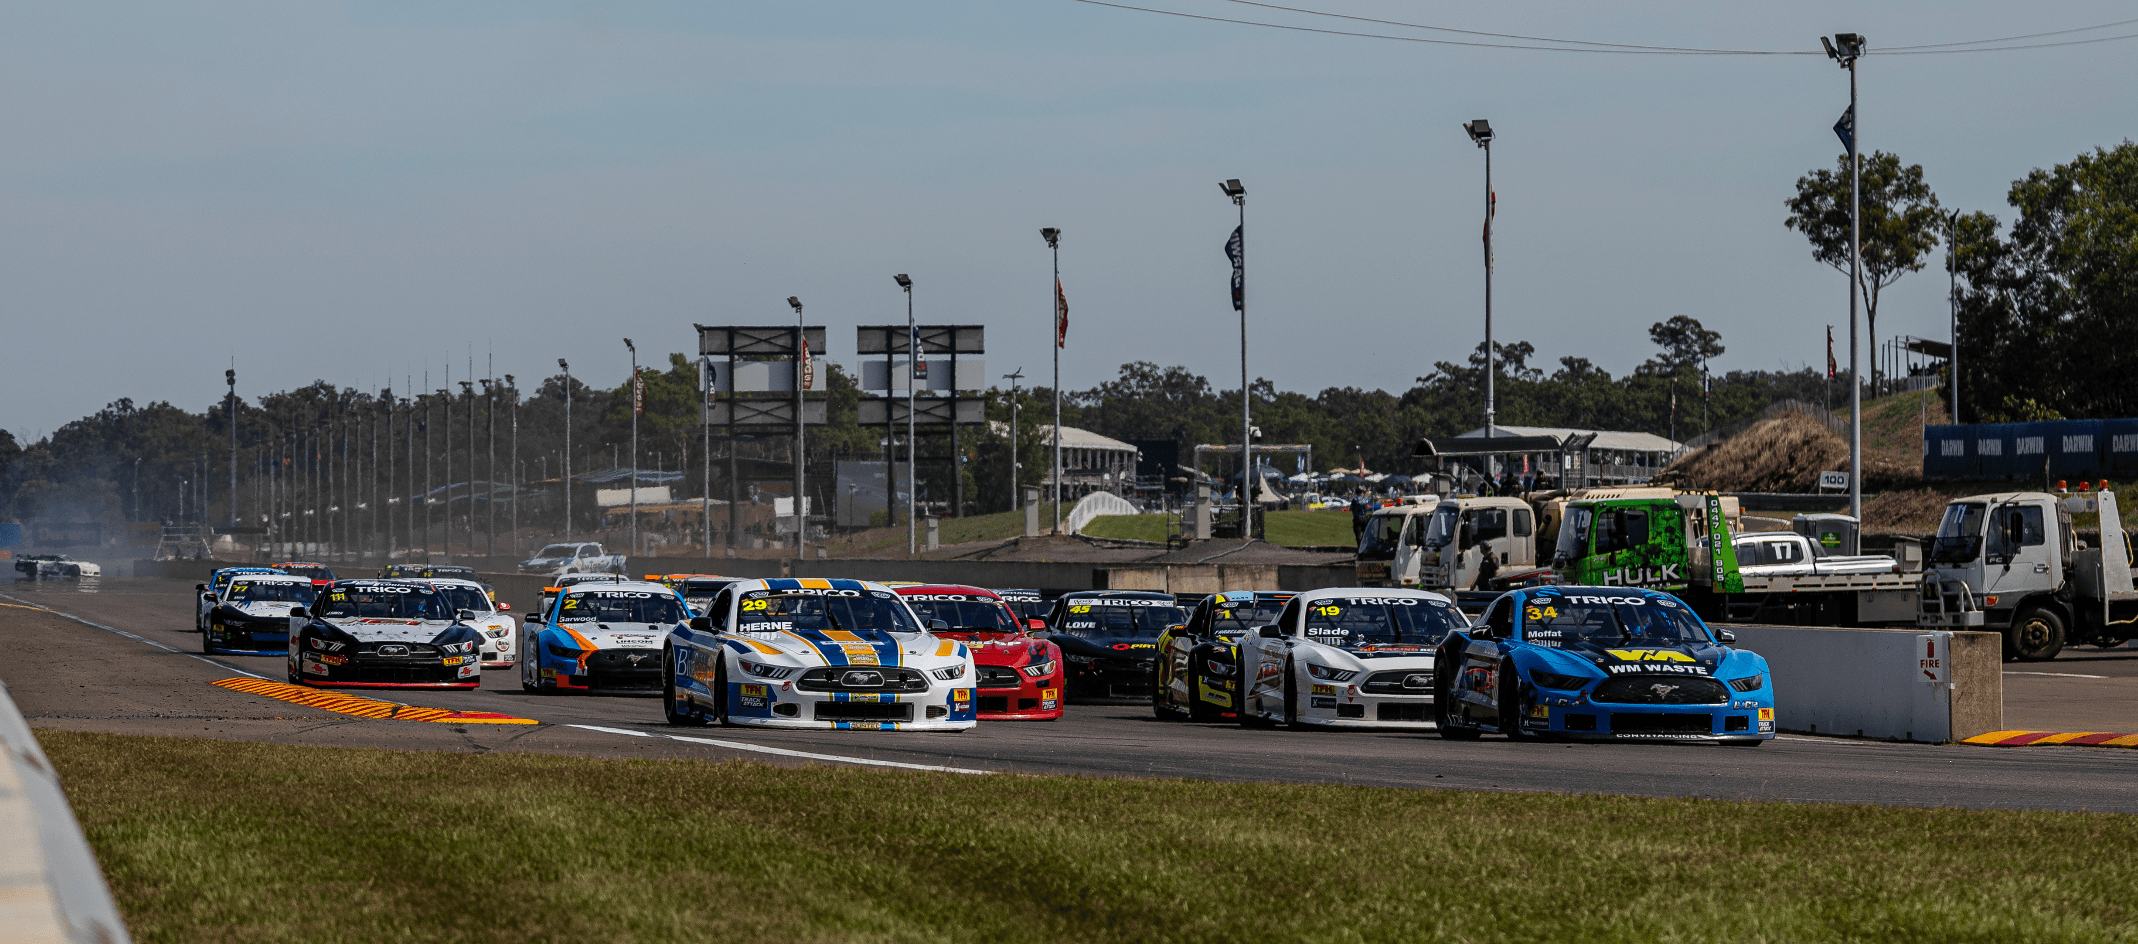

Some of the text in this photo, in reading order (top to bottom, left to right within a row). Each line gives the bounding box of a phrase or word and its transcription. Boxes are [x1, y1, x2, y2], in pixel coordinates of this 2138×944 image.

[1940, 438, 1964, 456] DARWIN
[1977, 438, 2002, 456] DARWIN
[2016, 436, 2044, 455] DARWIN
[2062, 434, 2094, 453] DARWIN
[1824, 475, 1845, 484] 100
[1710, 499, 1720, 529] 0447
[1603, 563, 1681, 586] HULK
[233, 585, 248, 593] 77
[354, 586, 412, 594] TRICO
[781, 588, 860, 597] TRICO
[329, 593, 345, 601] 111
[593, 591, 652, 599] TRICO
[900, 594, 967, 602] TRICO
[1002, 595, 1042, 603] RICO
[563, 599, 577, 610] 2
[1345, 597, 1418, 606] TRICO
[1563, 595, 1646, 606] TRICO
[742, 599, 767, 612] 29
[1069, 605, 1092, 614] 45
[1219, 609, 1231, 619] 1
[1316, 605, 1341, 616] 19
[1527, 606, 1558, 620] 34
[739, 621, 793, 632] HERNE
[1065, 621, 1097, 629] LOVE
[1307, 627, 1350, 636] Slade
[1527, 630, 1562, 638] Moffat
[1920, 659, 1940, 668] FIRE
[1608, 663, 1709, 675] WM WASTE
